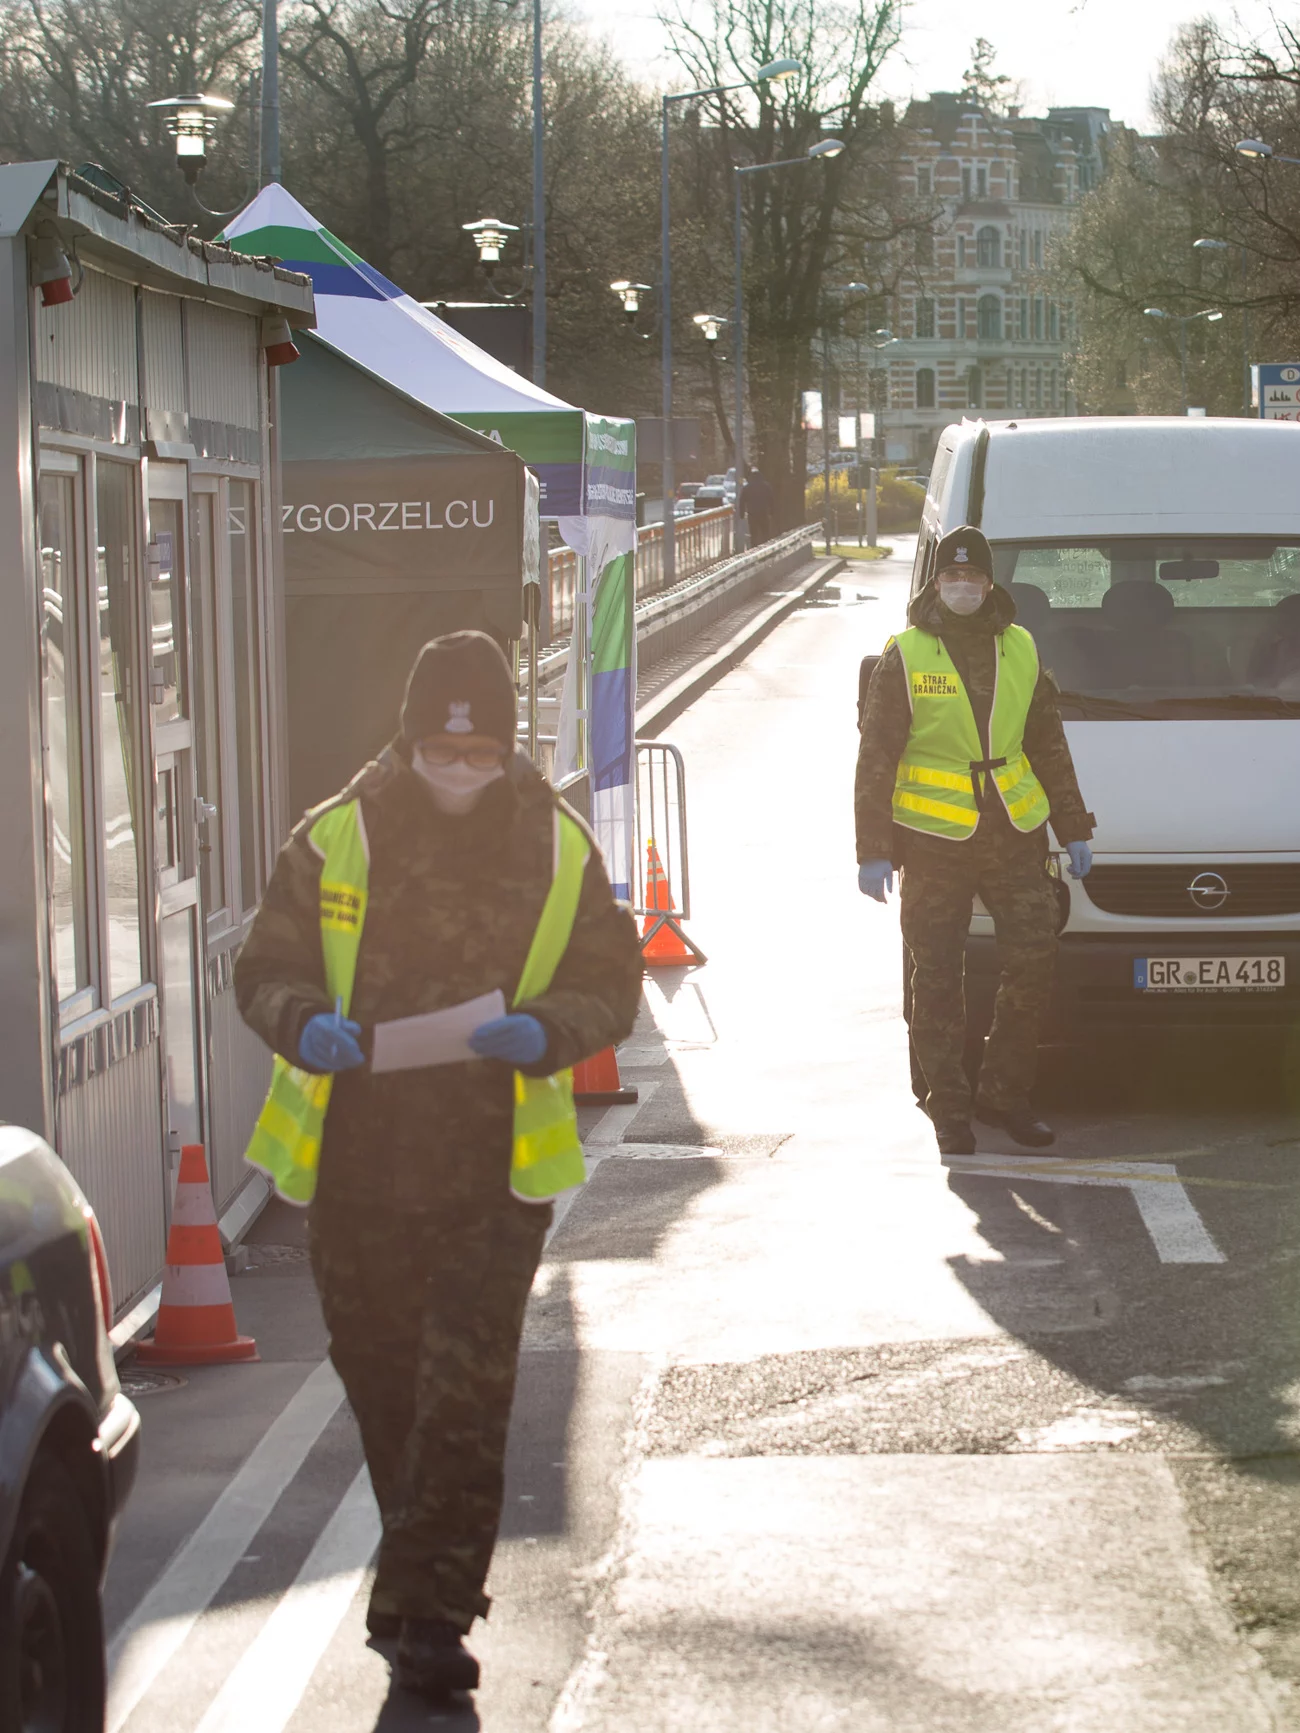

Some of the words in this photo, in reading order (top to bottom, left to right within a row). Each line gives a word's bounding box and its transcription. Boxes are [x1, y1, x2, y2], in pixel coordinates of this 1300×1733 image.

[1287, 370, 1295, 379] D
[281, 499, 494, 533] ZGORZELCU
[1150, 961, 1181, 984] GR
[1199, 961, 1230, 984] EA
[1236, 960, 1281, 983] 418
